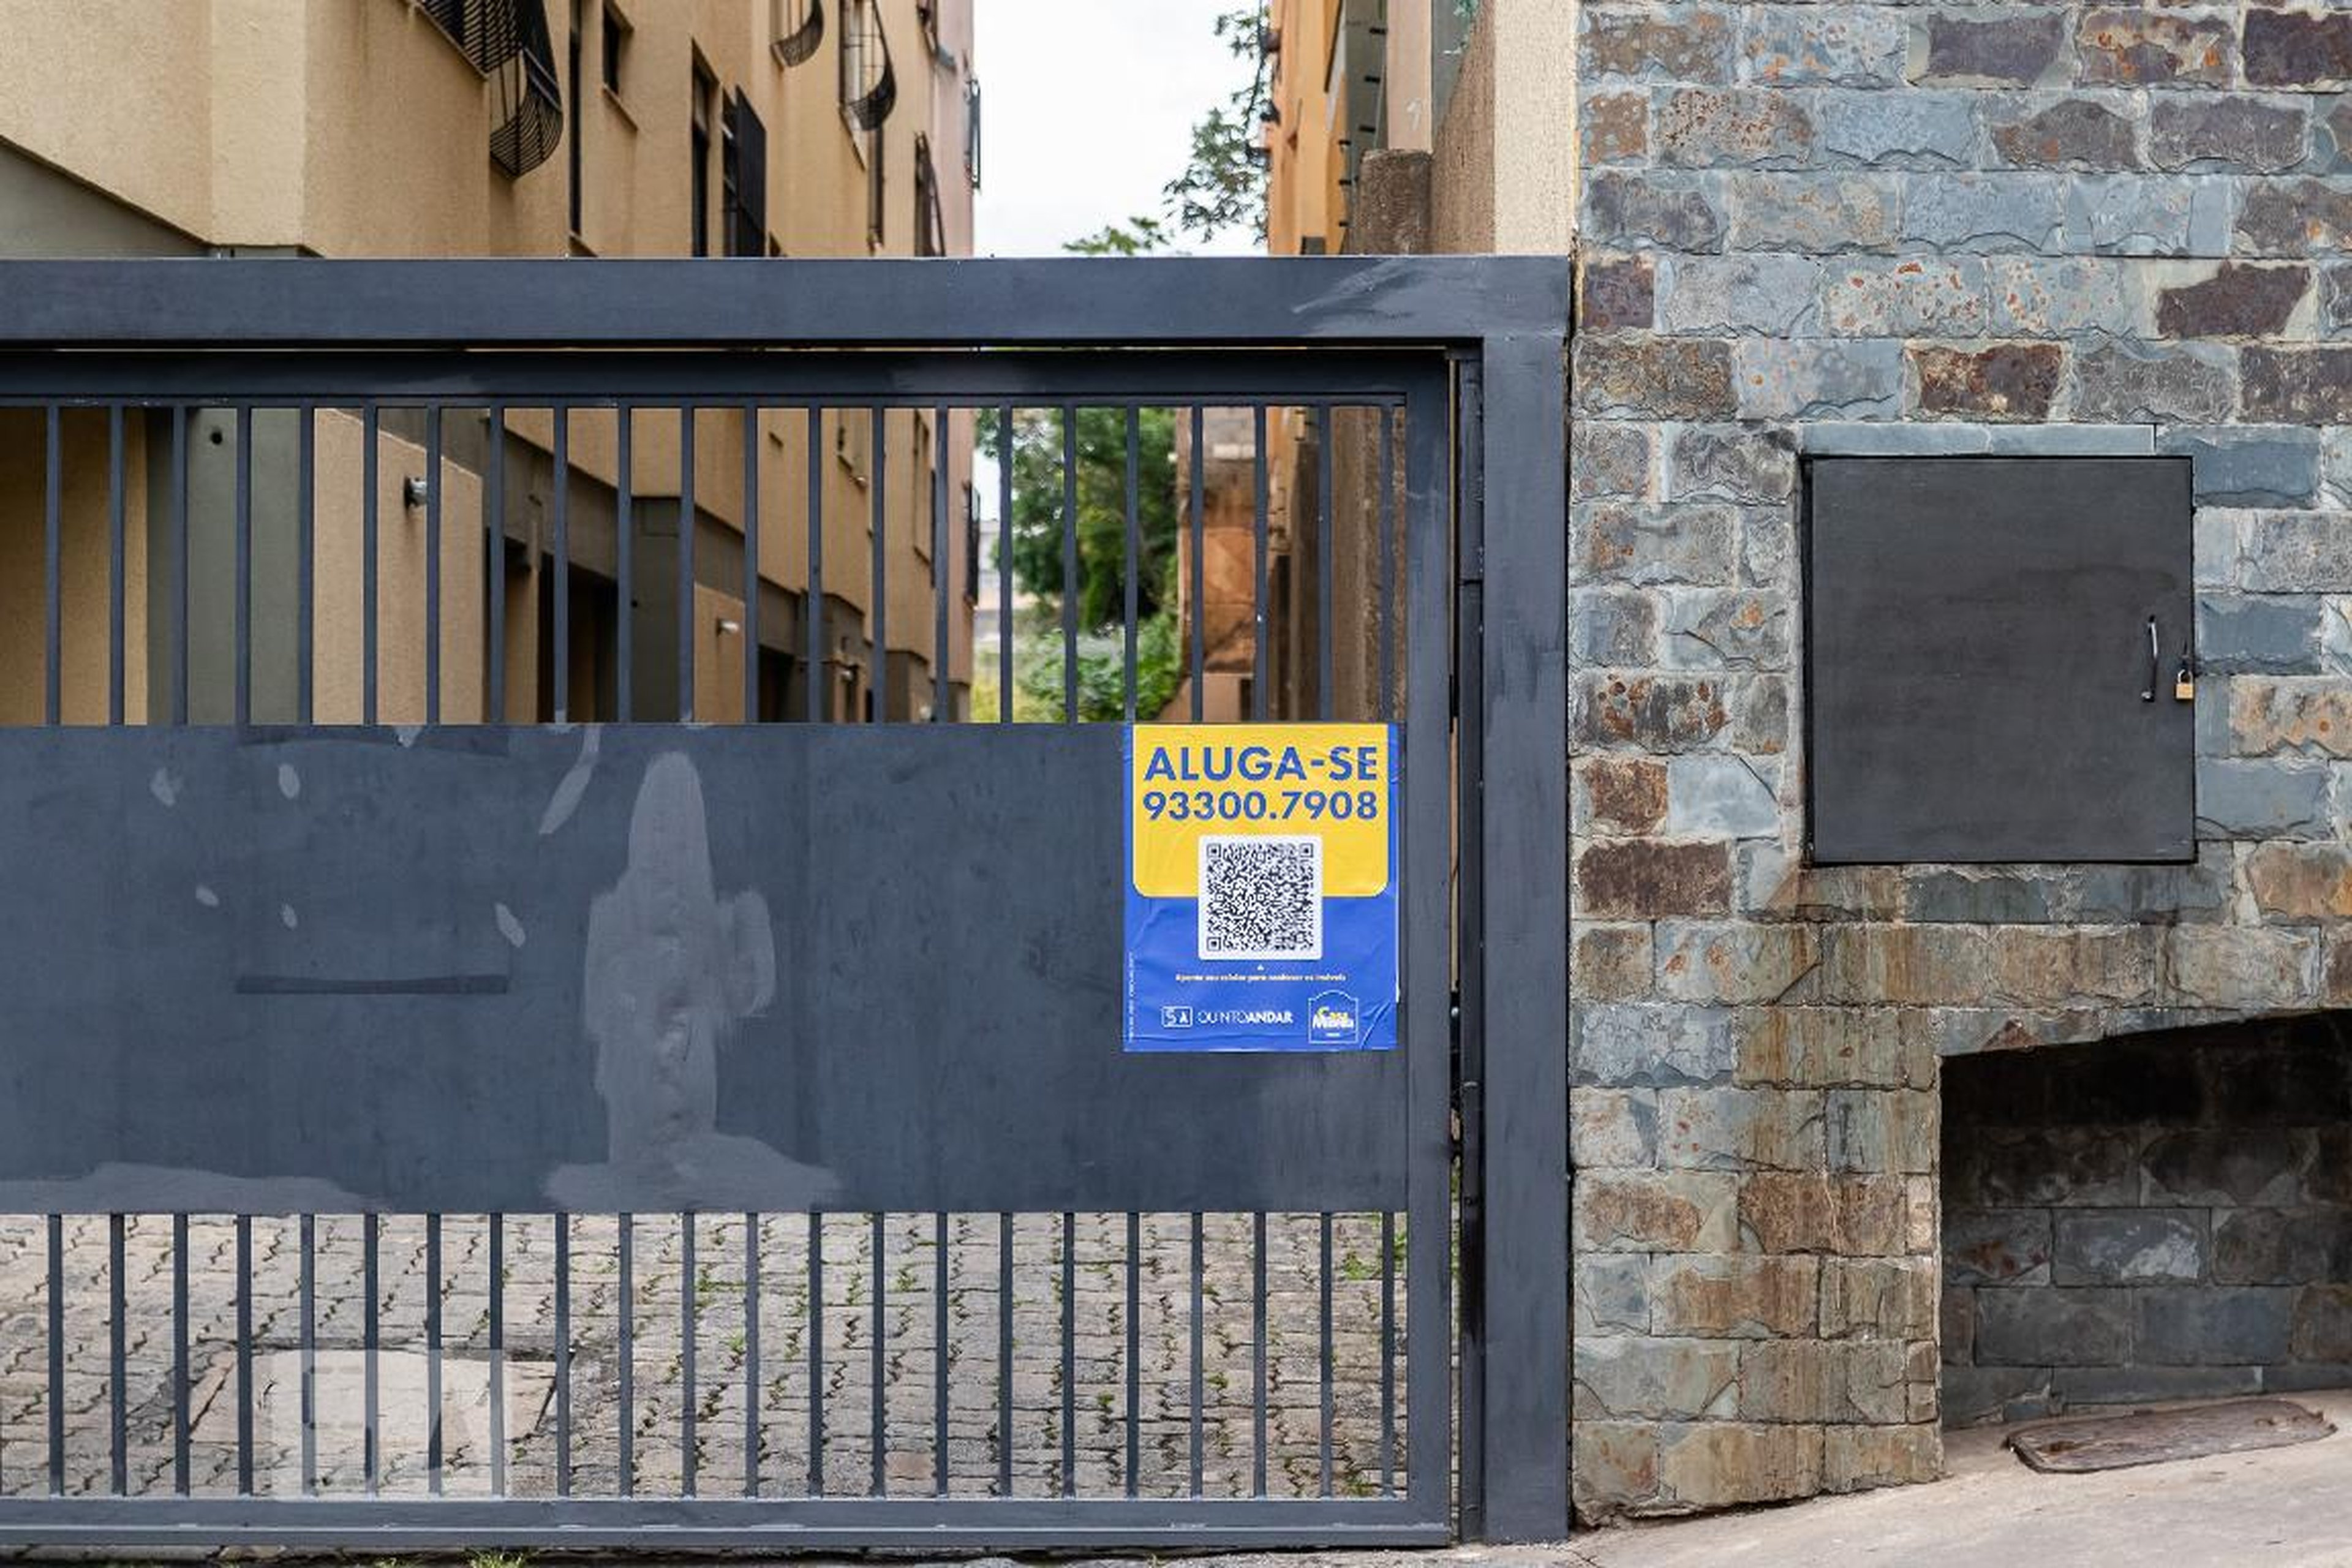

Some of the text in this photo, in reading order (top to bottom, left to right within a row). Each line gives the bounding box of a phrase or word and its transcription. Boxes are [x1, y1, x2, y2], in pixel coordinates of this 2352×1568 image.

[1144, 745, 1378, 781] ALUGA-SE
[1143, 790, 1378, 820] 93300.7908
[1197, 1010, 1294, 1024] QUNTOANDAR
